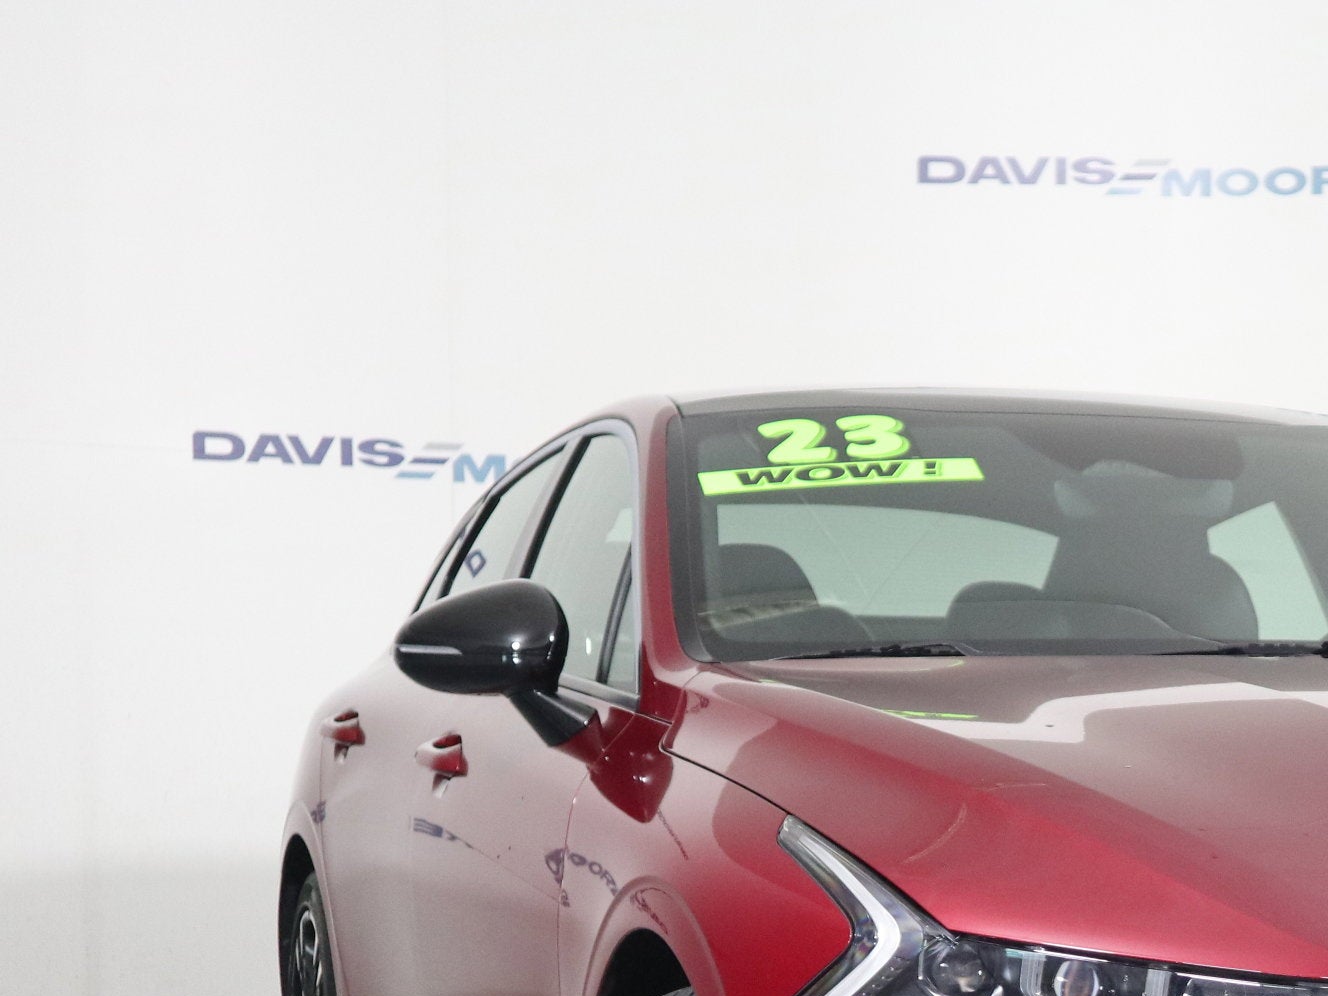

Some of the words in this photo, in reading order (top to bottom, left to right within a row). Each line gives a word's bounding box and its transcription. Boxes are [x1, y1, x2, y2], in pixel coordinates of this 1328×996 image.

[917, 156, 1115, 185] DAVIS
[194, 431, 406, 468] DAVIS
[757, 414, 911, 464] 23
